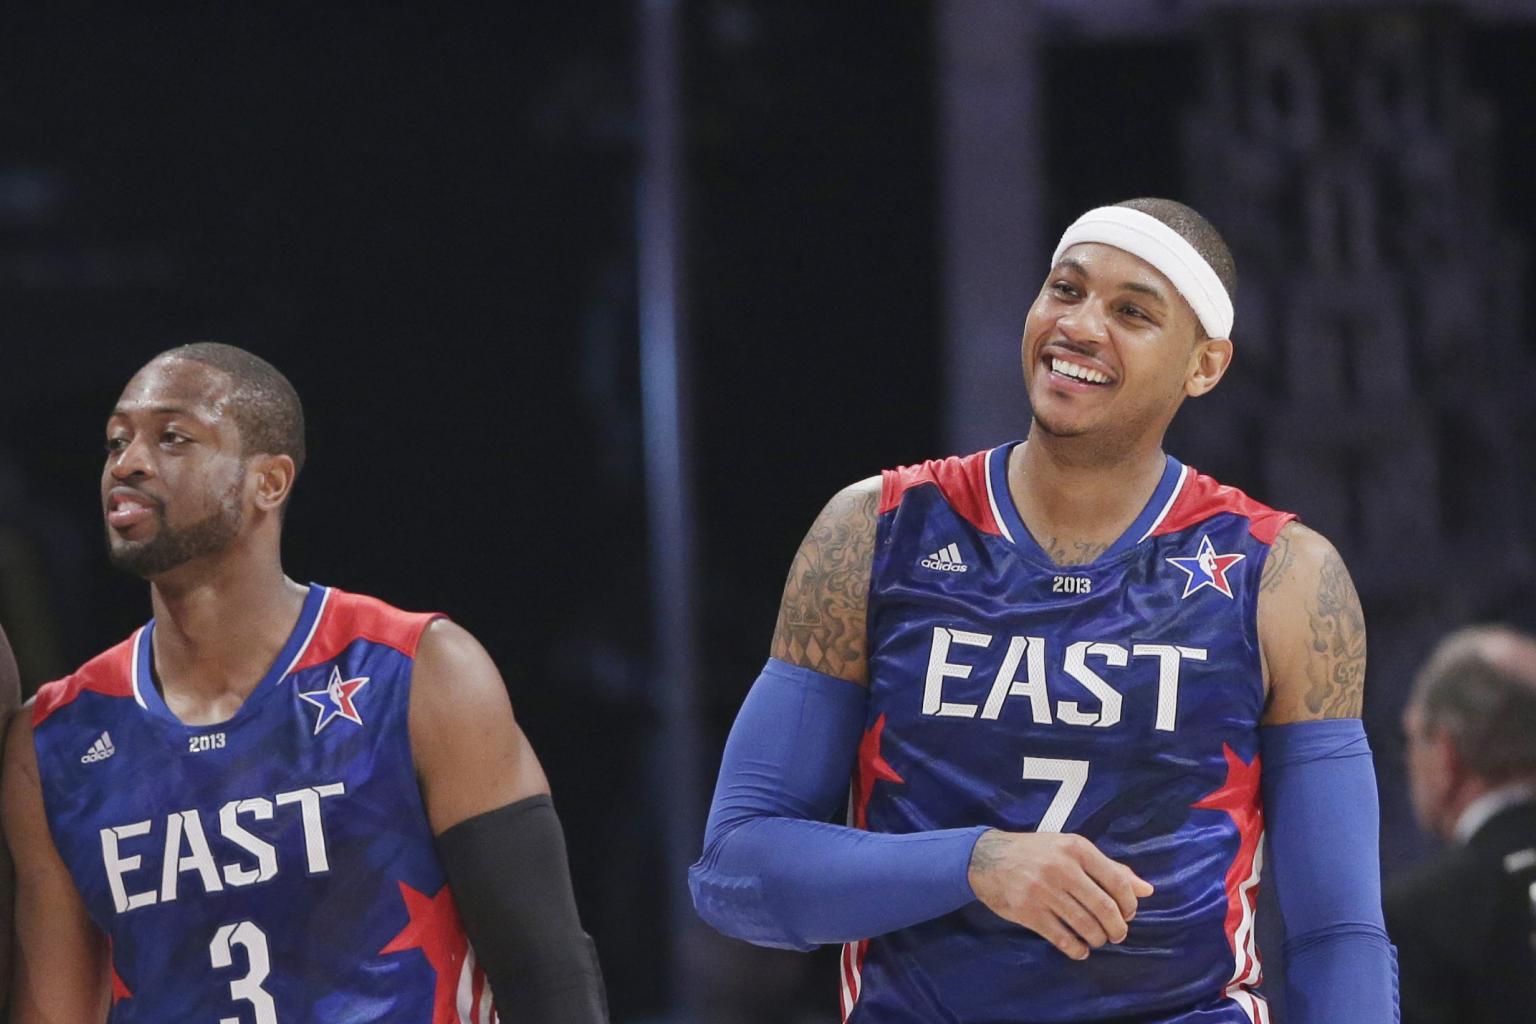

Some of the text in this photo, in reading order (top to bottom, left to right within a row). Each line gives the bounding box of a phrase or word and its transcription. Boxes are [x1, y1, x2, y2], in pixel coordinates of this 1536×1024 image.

[921, 558, 967, 572] adidas
[1052, 575, 1092, 594] 2013
[921, 626, 1208, 732] EAST
[188, 732, 226, 753] 2013
[1022, 756, 1090, 833] 7
[99, 782, 345, 913] EAST
